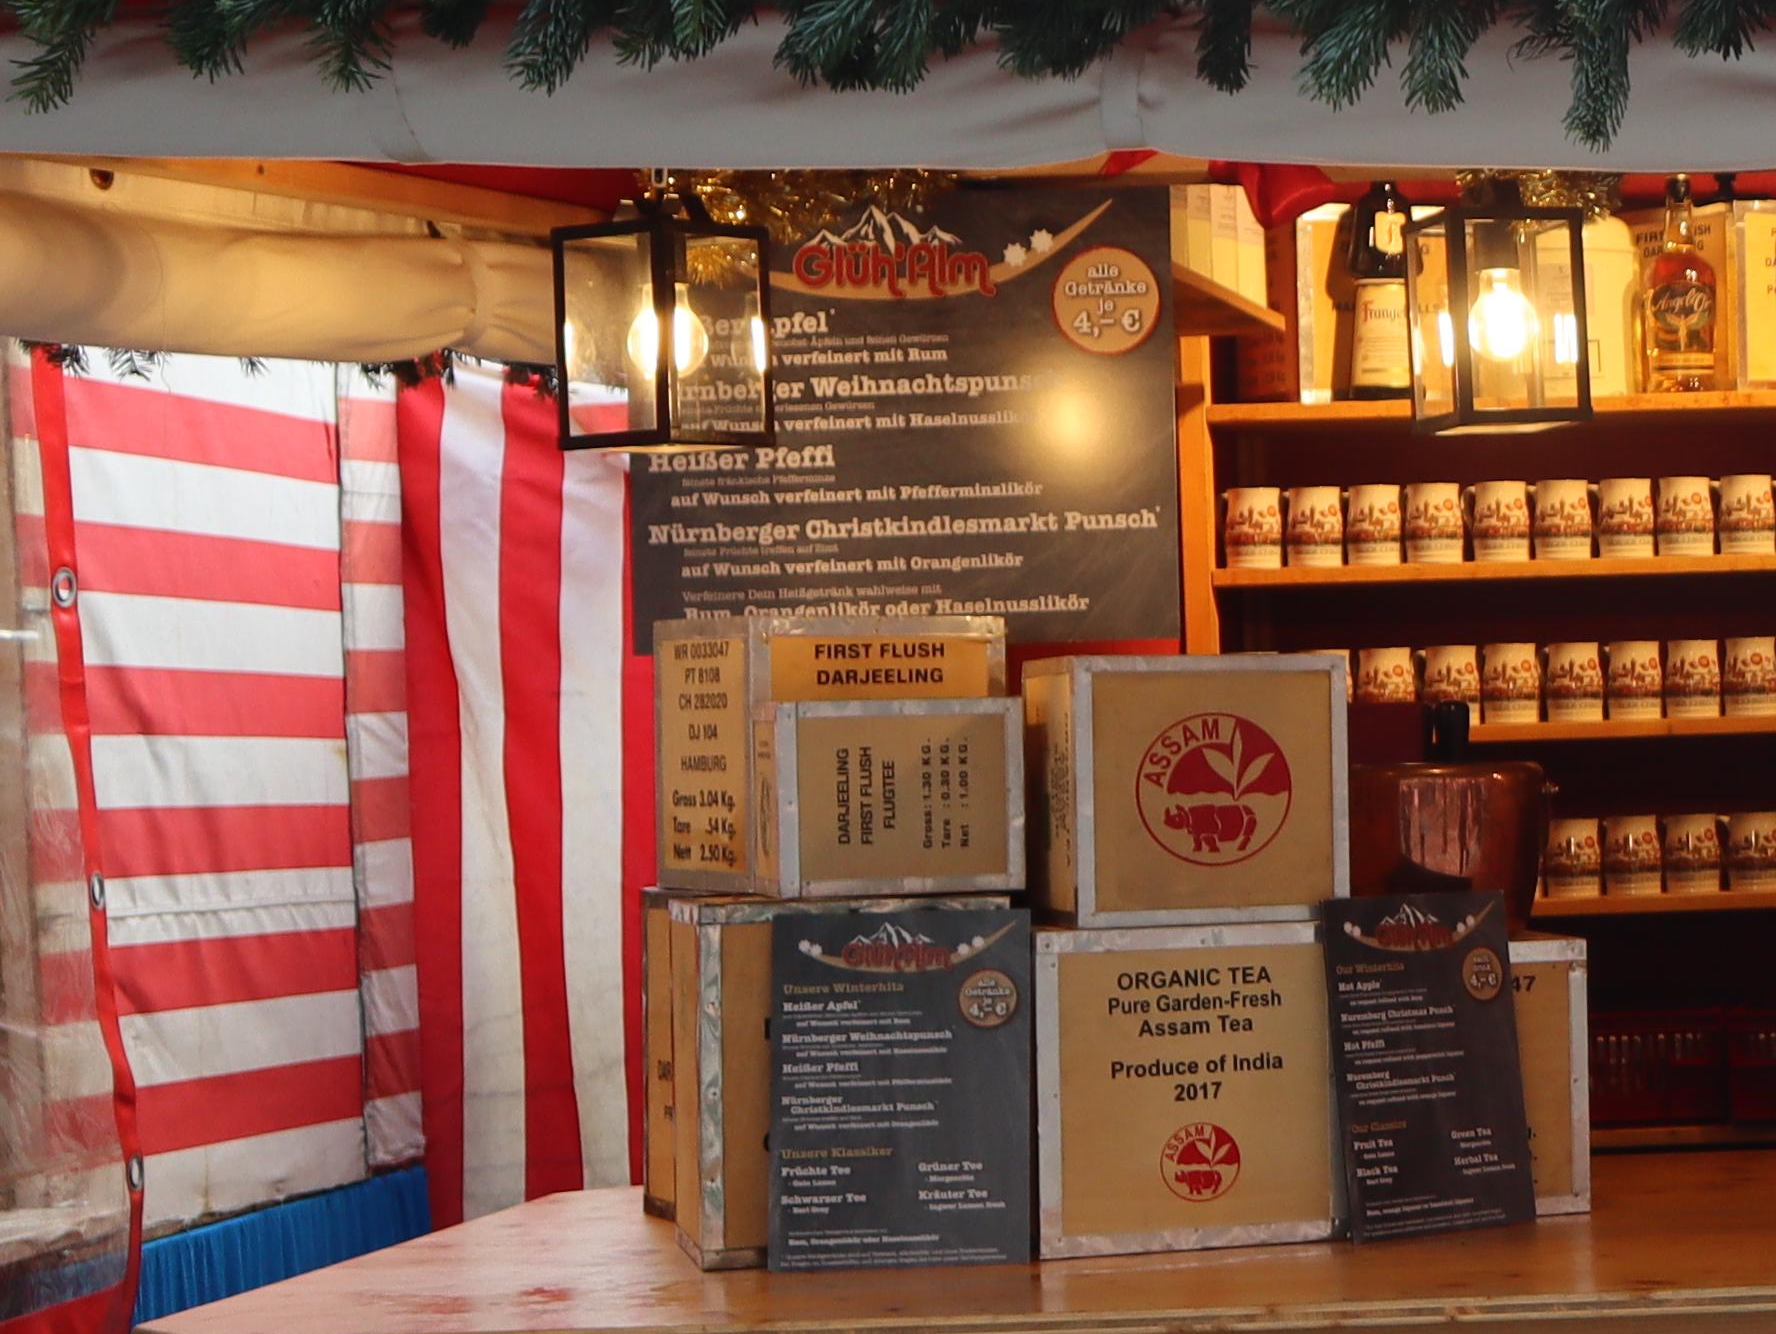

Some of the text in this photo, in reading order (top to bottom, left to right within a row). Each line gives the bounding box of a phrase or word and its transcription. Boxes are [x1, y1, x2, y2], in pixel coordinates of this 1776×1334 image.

[1088, 264, 1119, 278] alle
[1065, 280, 1147, 296] Getränke
[1098, 297, 1114, 314] je
[648, 445, 835, 473] Heißer Pfeffi
[671, 492, 697, 507] auf
[703, 490, 770, 506] Wunsch
[774, 487, 862, 504] verfeinert
[866, 486, 896, 500] mit
[648, 523, 800, 545] Nürnberger
[805, 511, 1058, 539] Christkindlesmarkt
[674, 641, 729, 660] WR 0033047
[814, 642, 945, 659] FIRST FLUSH
[685, 668, 697, 683] PT
[816, 668, 943, 685] DARJEELING
[679, 695, 692, 710] CH
[689, 723, 718, 740] DJ 104
[681, 755, 727, 772] HAMBURG
[921, 738, 932, 766] KG.
[940, 738, 951, 765] KG.
[1143, 716, 1220, 788] ASSAM
[836, 747, 850, 845] DARJEELING
[860, 746, 874, 845] FIRST FLUSH
[883, 760, 896, 830] FLUGTEE
[922, 769, 933, 801] 1.30
[940, 769, 951, 801] 0.30
[958, 737, 970, 848] Net 1.00 KG.
[672, 791, 735, 812] Gross 3.04 Kg.
[673, 819, 691, 835] Tare
[721, 820, 736, 839] Kg.
[673, 846, 736, 867] Nett 2.50 Kg.
[1117, 966, 1271, 991] ORGANIC TEA
[1107, 988, 1282, 1016] Pure Garden-Fresh
[1138, 1013, 1254, 1038] Assam Tea
[1111, 1051, 1283, 1080] Produce of India
[1174, 1080, 1222, 1103] 2017
[1164, 1124, 1206, 1163] ASSAM
